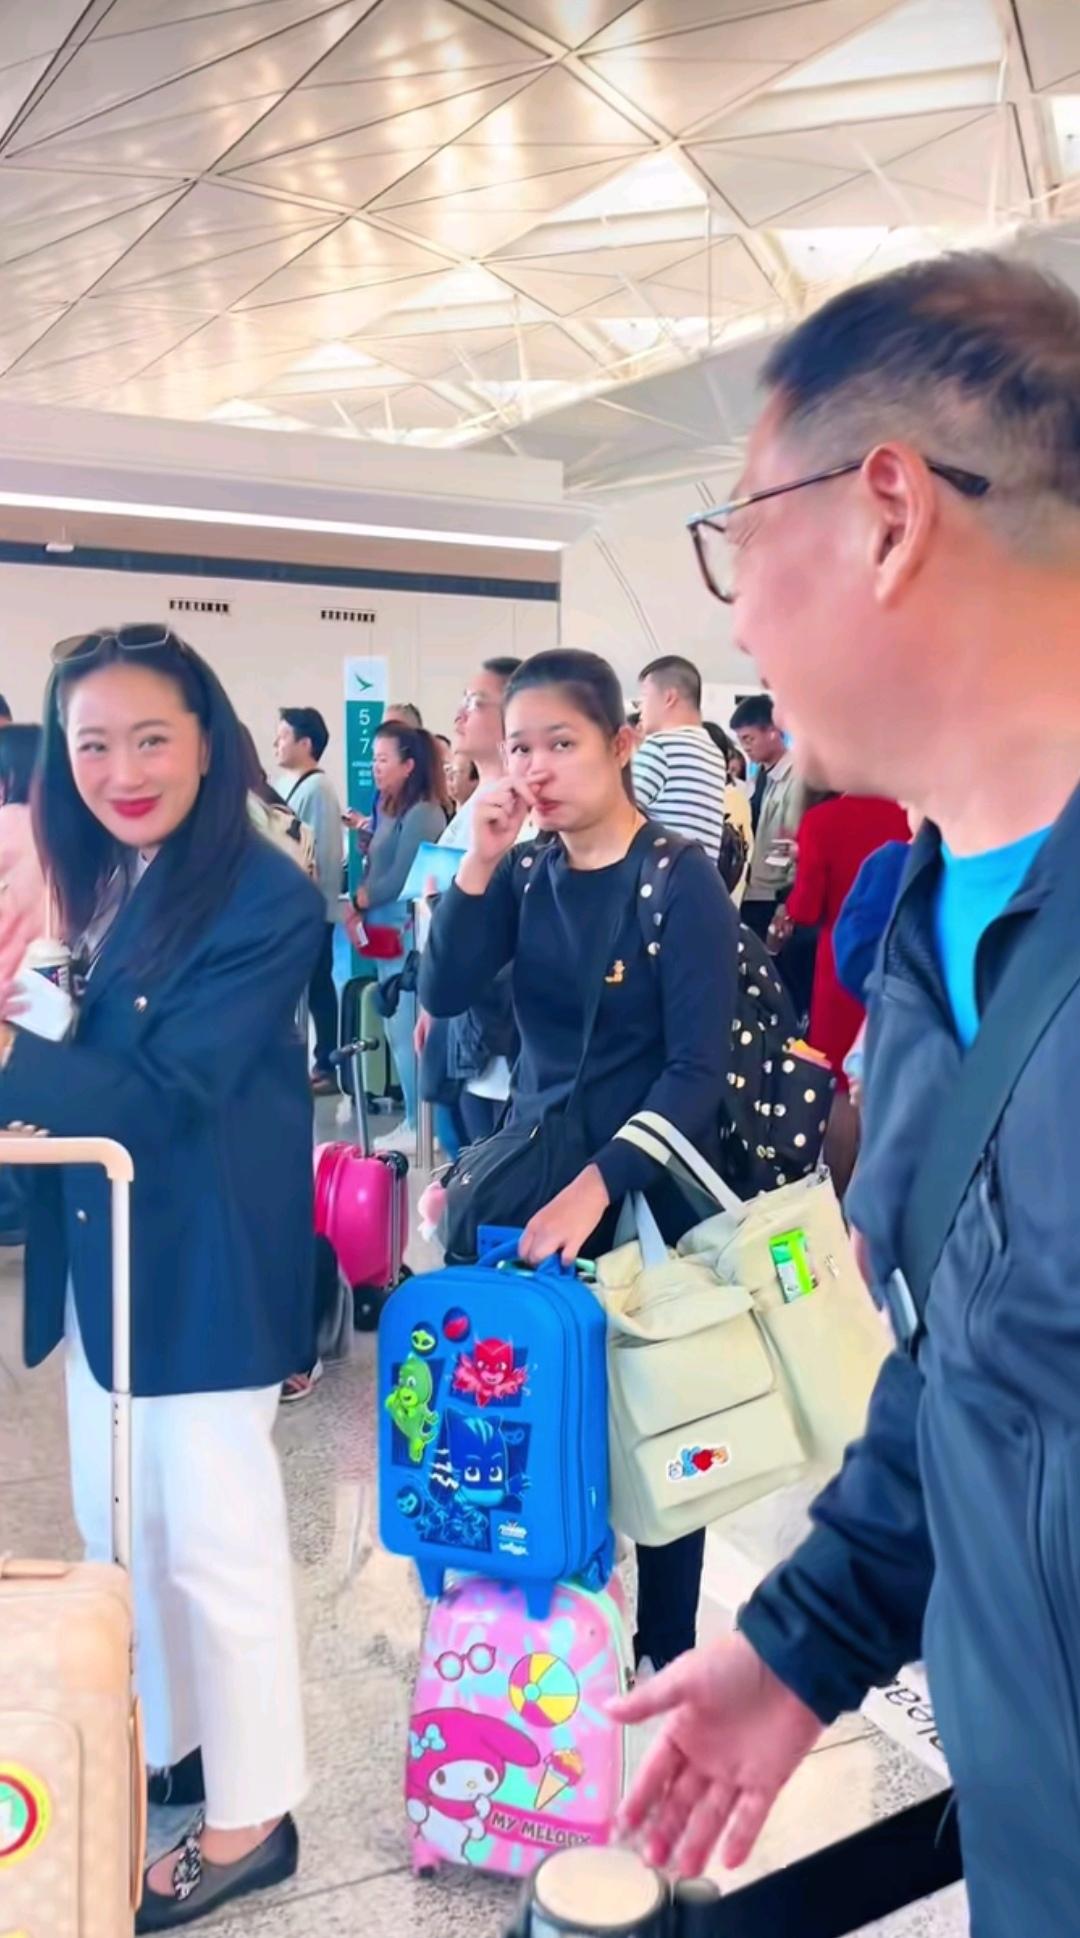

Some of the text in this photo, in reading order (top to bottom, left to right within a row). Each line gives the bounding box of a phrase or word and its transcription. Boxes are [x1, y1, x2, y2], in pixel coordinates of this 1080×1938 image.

[359, 708, 371, 726] 5
[359, 737, 371, 754] 7
[491, 1812, 517, 1831] MY
